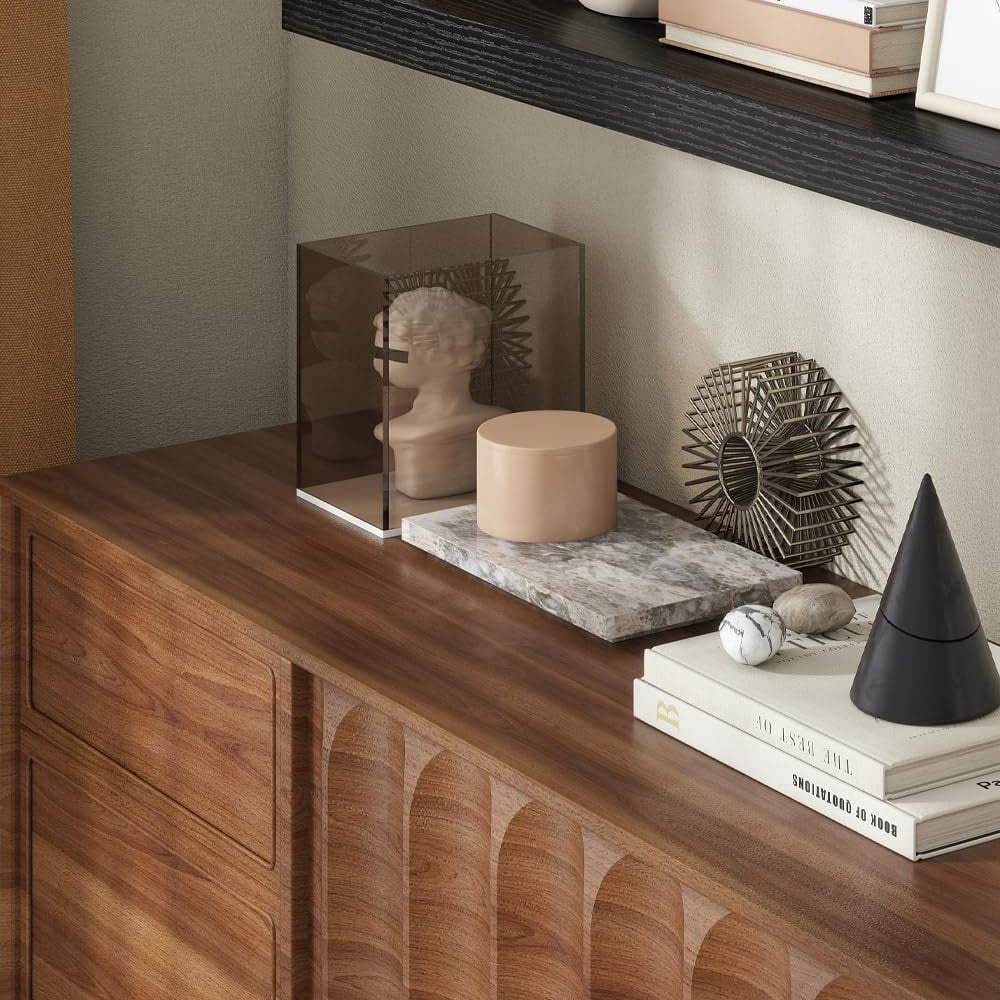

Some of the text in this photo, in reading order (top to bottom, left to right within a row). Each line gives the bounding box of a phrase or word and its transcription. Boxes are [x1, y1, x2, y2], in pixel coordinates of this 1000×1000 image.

[779, 727, 815, 757] BEST
[823, 747, 853, 776] THE
[792, 773, 898, 838] BOOK OF QUOTATIONS
